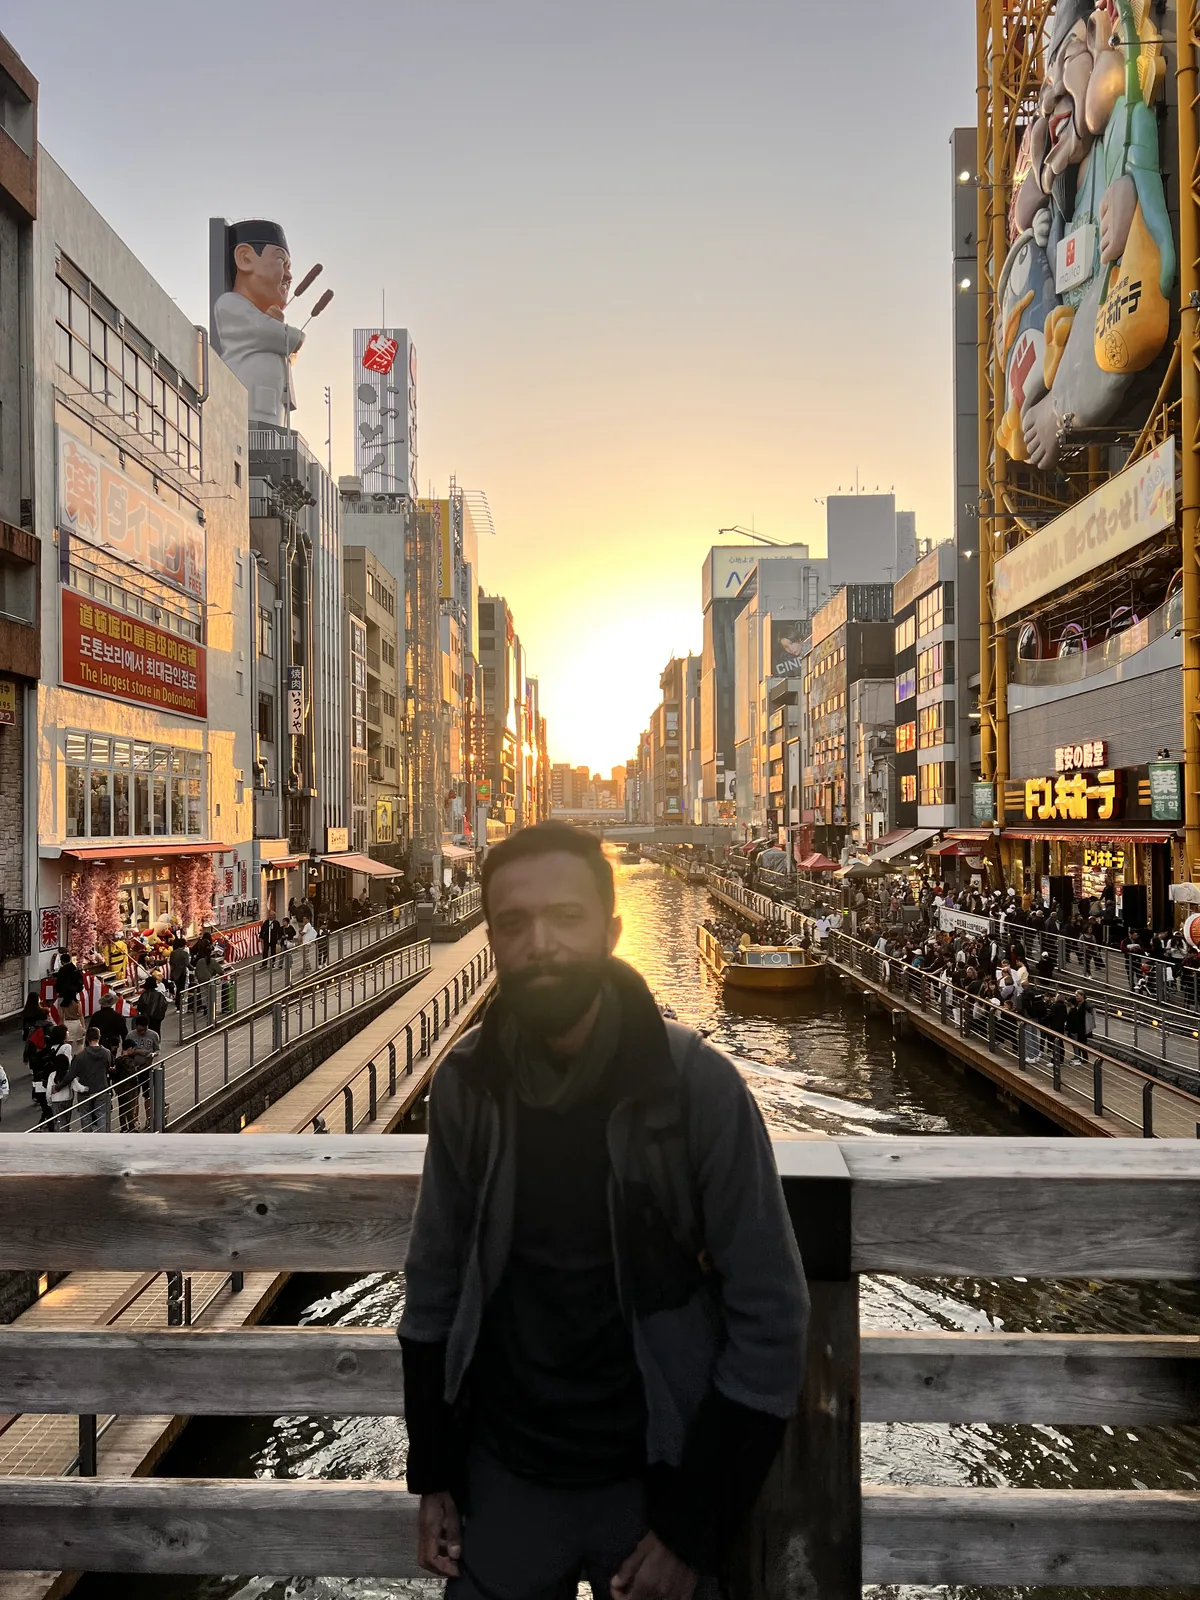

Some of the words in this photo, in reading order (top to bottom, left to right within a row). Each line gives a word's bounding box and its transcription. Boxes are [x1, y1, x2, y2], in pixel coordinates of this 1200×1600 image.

[62, 441, 98, 533] 薬
[107, 484, 185, 574] ダイコク
[80, 634, 144, 675] 도톤보리에서
[146, 657, 197, 690] 최대급인점포
[291, 669, 301, 689] 焼肉
[80, 662, 98, 683] The
[100, 668, 130, 692] largest
[132, 680, 152, 698] store
[153, 684, 161, 701] in
[162, 687, 196, 710] Dotonbori
[975, 788, 992, 804] 薬
[1151, 770, 1178, 793] 薬
[1168, 800, 1179, 812] 약
[42, 910, 59, 948] 薬
